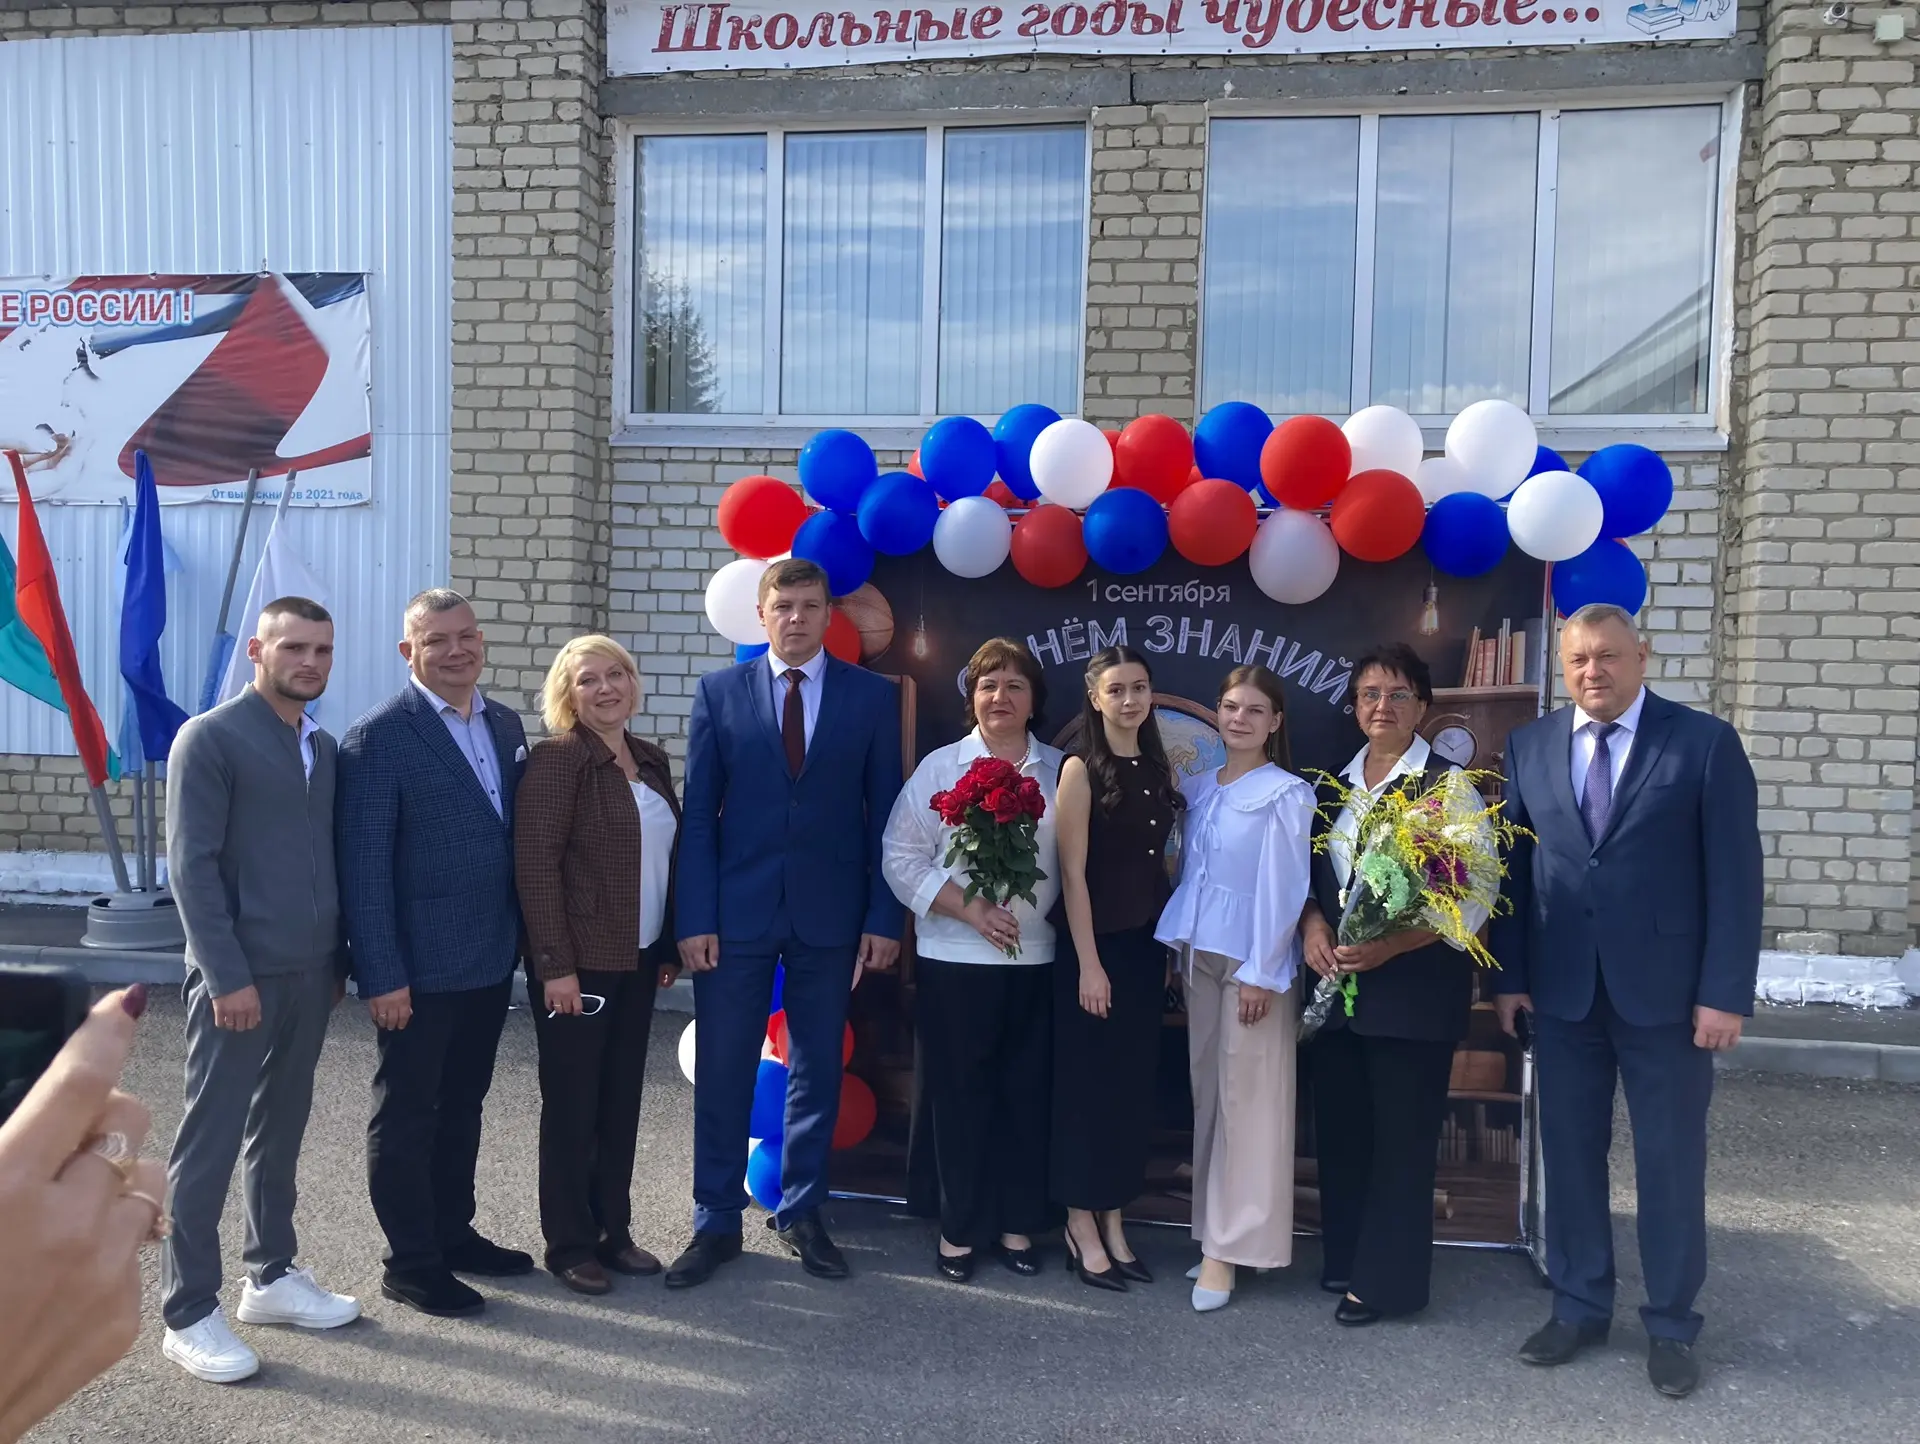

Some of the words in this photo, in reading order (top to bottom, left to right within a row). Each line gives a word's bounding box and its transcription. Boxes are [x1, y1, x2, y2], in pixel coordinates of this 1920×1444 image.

[651, 3, 1004, 53] Школьные
[1017, 0, 1184, 36] годы
[211, 488, 226, 499] От
[227, 490, 303, 500] выскниов
[305, 489, 336, 500] 2021
[337, 490, 363, 500] года
[1086, 578, 1098, 602] 1
[1104, 579, 1231, 608] сентября
[1026, 616, 1129, 669] НЁМ
[1144, 614, 1354, 715] ЗНАНИЙ
